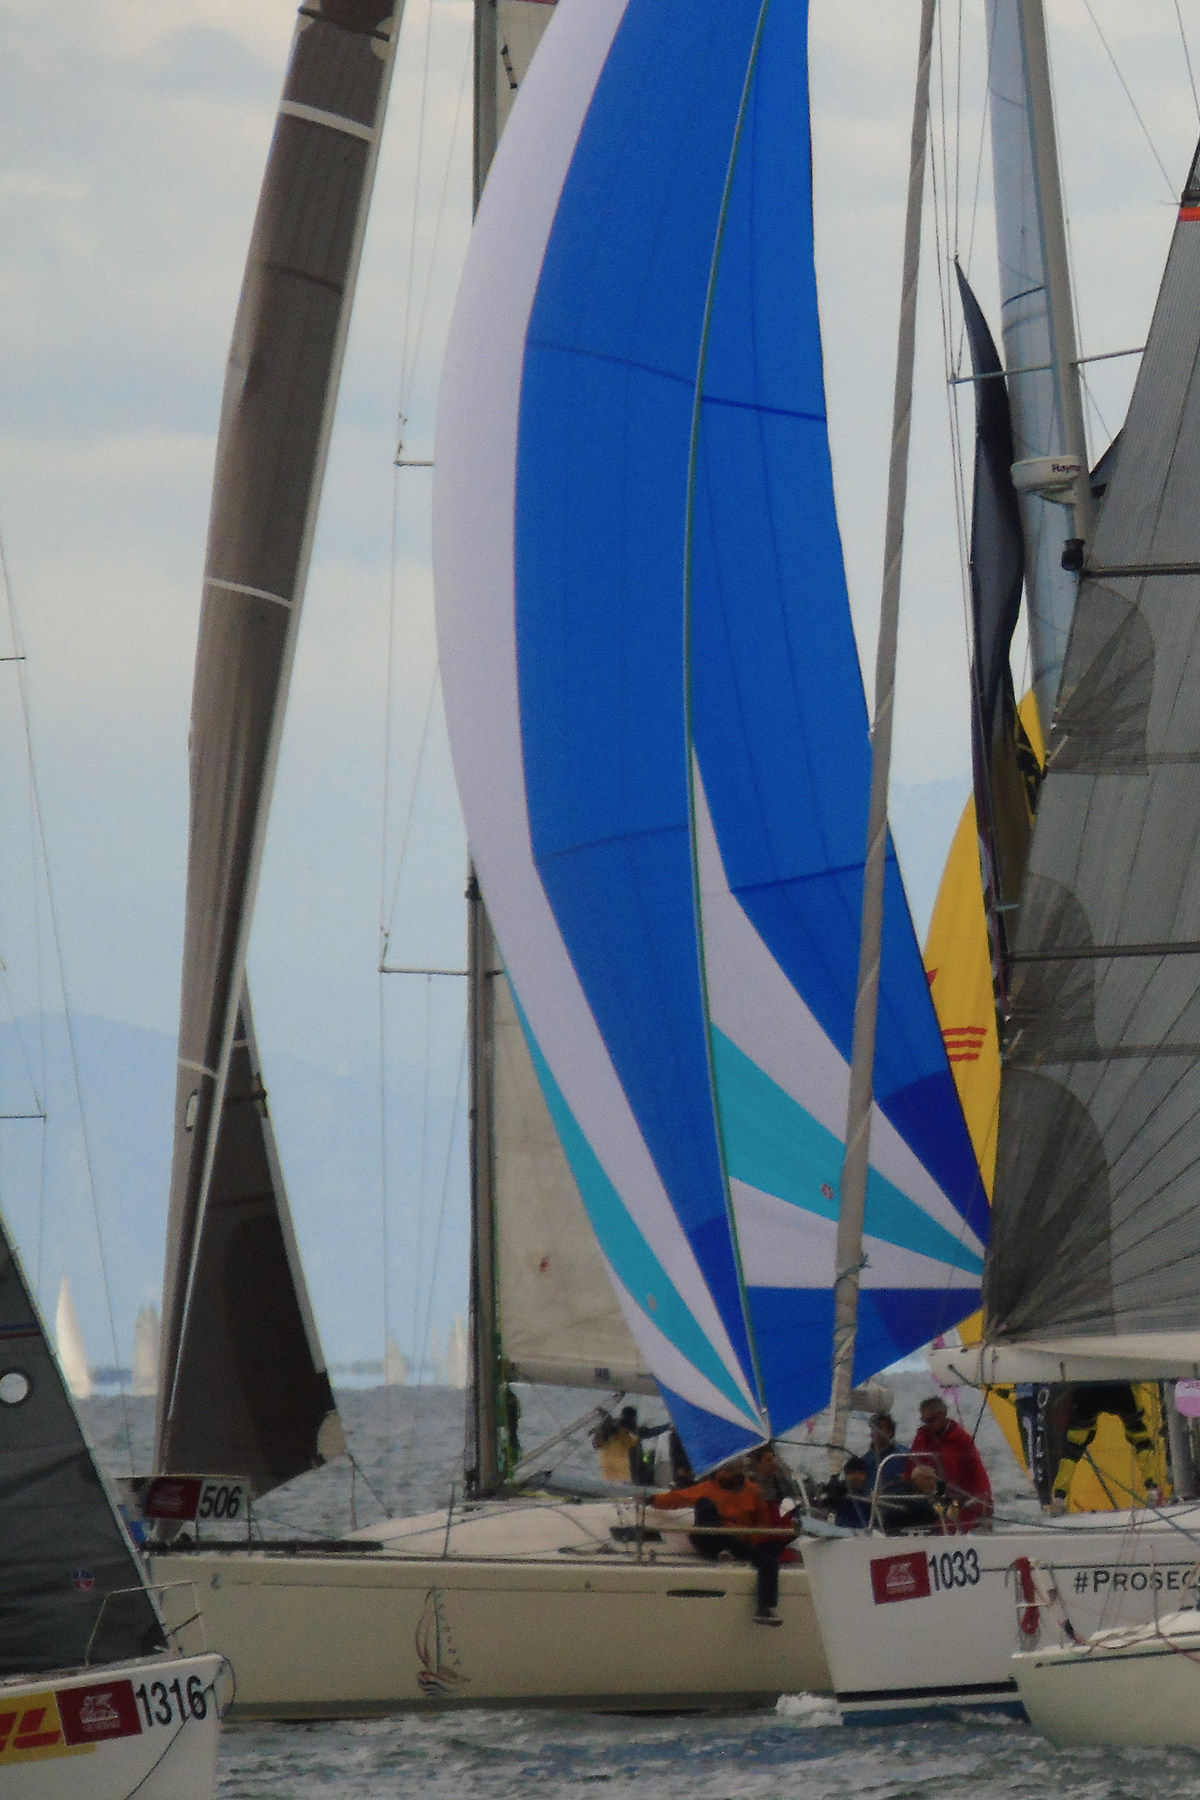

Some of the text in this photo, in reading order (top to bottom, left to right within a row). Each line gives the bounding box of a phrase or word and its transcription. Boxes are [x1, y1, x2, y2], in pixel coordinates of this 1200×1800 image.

[199, 1486, 242, 1518] 506
[929, 1548, 980, 1590] 1033
[137, 1676, 207, 1727] 1316
